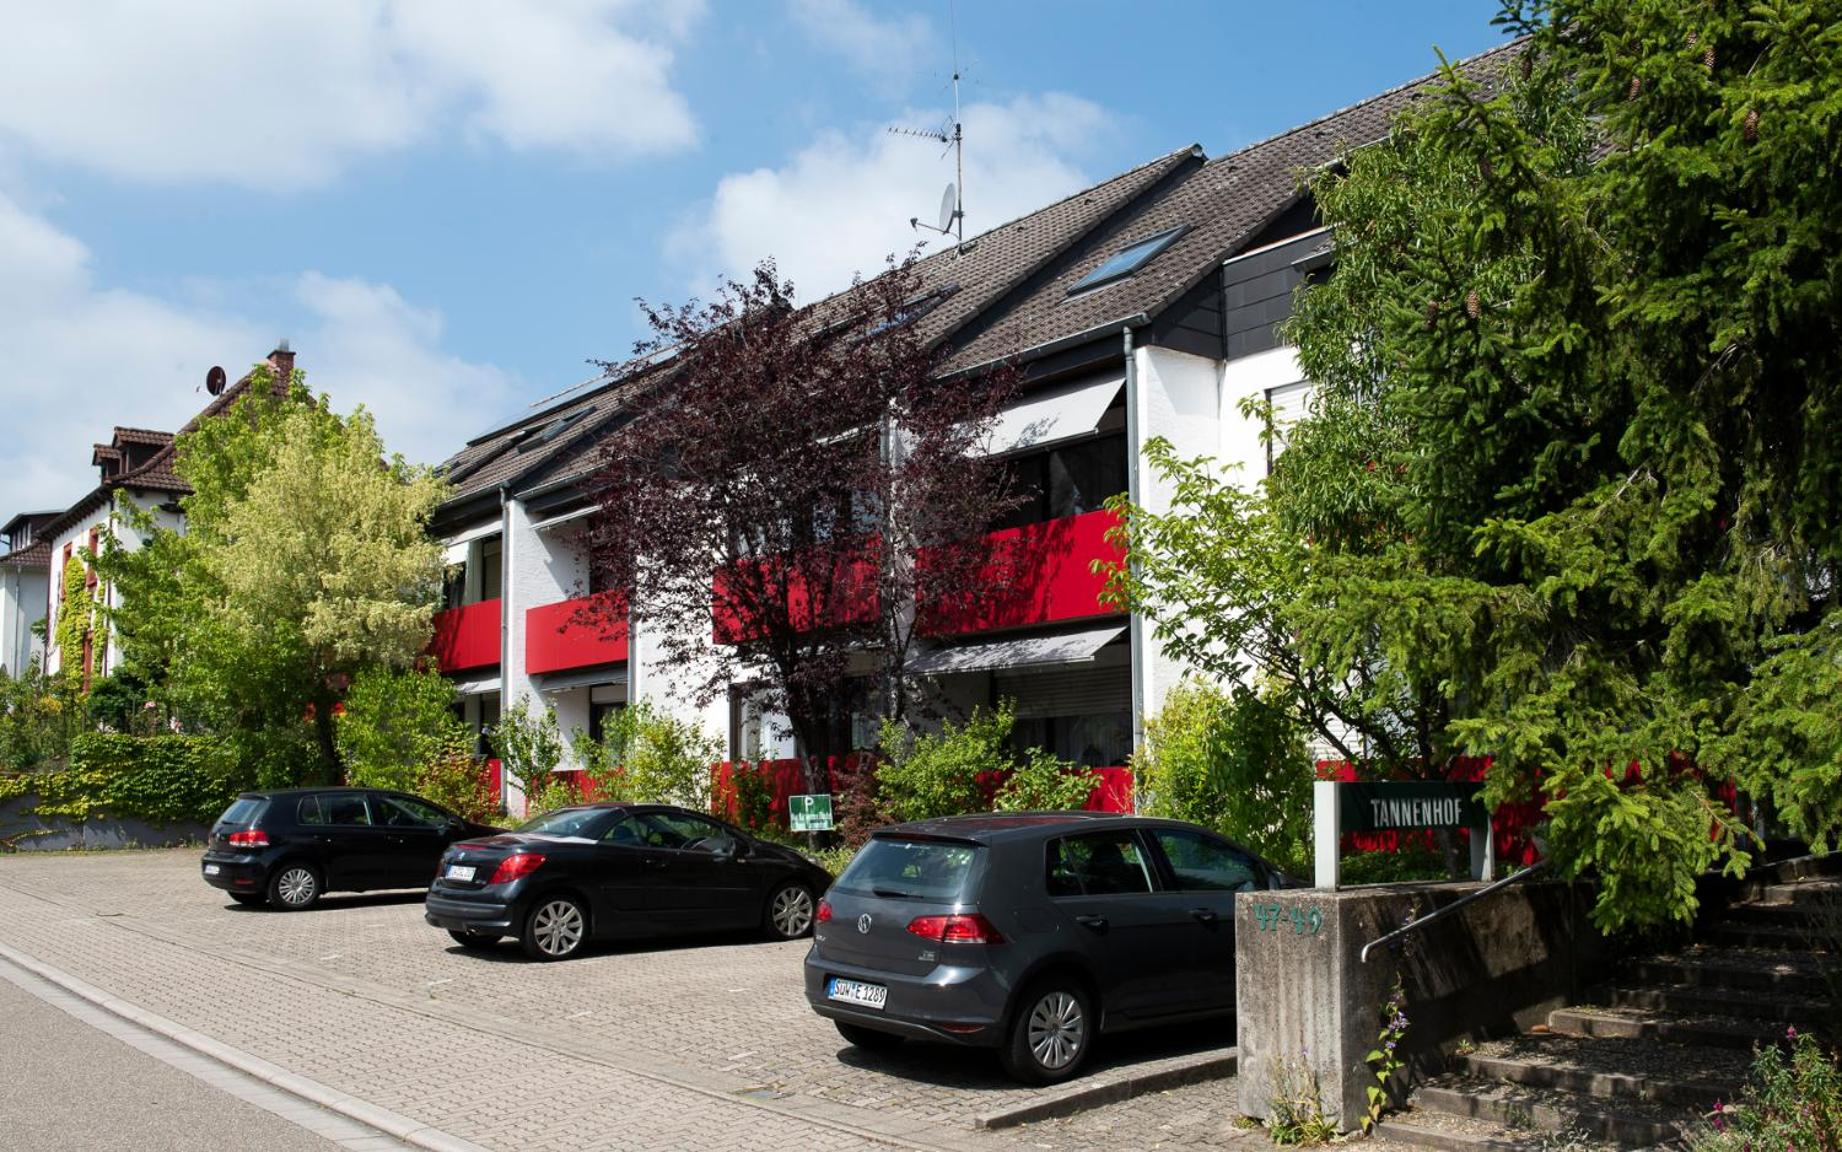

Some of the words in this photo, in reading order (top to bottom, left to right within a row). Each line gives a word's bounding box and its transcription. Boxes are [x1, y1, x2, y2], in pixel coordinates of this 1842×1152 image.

[804, 796, 814, 812] P
[1370, 798, 1462, 827] TANNENHOF
[1252, 902, 1324, 936] 47-49
[862, 985, 885, 1004] 1289
